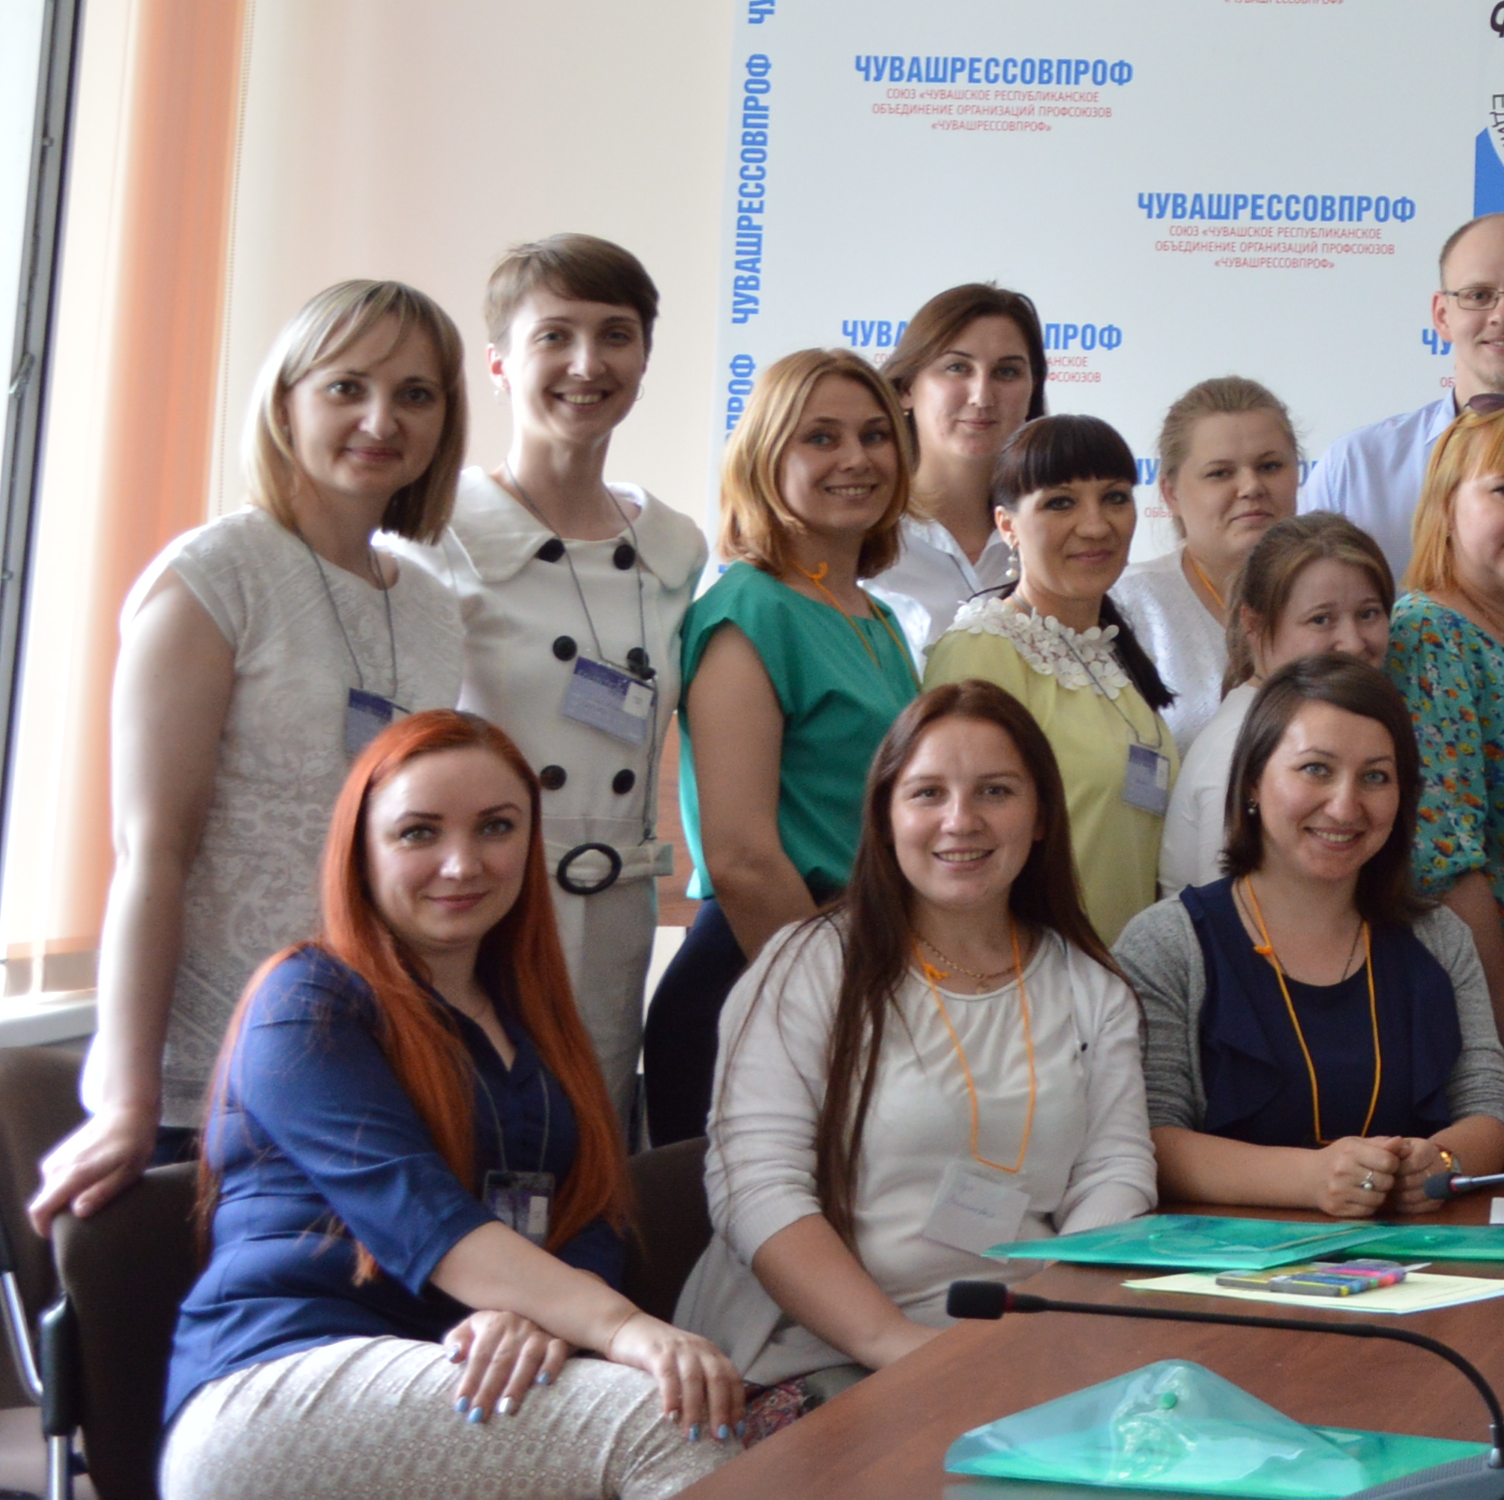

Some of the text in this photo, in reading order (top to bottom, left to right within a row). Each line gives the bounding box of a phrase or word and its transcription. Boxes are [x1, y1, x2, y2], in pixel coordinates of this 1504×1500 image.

[855, 55, 1133, 86] ЧУВАШРЕССОВПРОФ
[886, 88, 1101, 103] СОЮЗ «ЧУВАШСКОЕ РЕСПУБЛИКАНСКОЕ
[872, 103, 1113, 119] ОБЪЕДИНЕНИЕ ОРГАНИЗАЦИЙ ПРОФСОЮЗОВ
[931, 120, 1053, 132] «ЧУВАШРЕССОВПРОФ»
[731, 54, 772, 324] ЧУВАШРЕССОВПРОФ
[1138, 193, 1416, 222] ЧУВАШРЕССОВПРОФ
[1167, 225, 1382, 240] СОЮЗ «ЧУВАШСКОЕ РЕСПУБЛИКАНСКОЕ
[1154, 240, 1396, 256] ОБЪЕДИНЕНИЕ ОРГАНИЗАЦИЙ ПРОФСОЮЗОВ
[1214, 258, 1335, 270] «ЧУВАШРЕССОВПРОФ»
